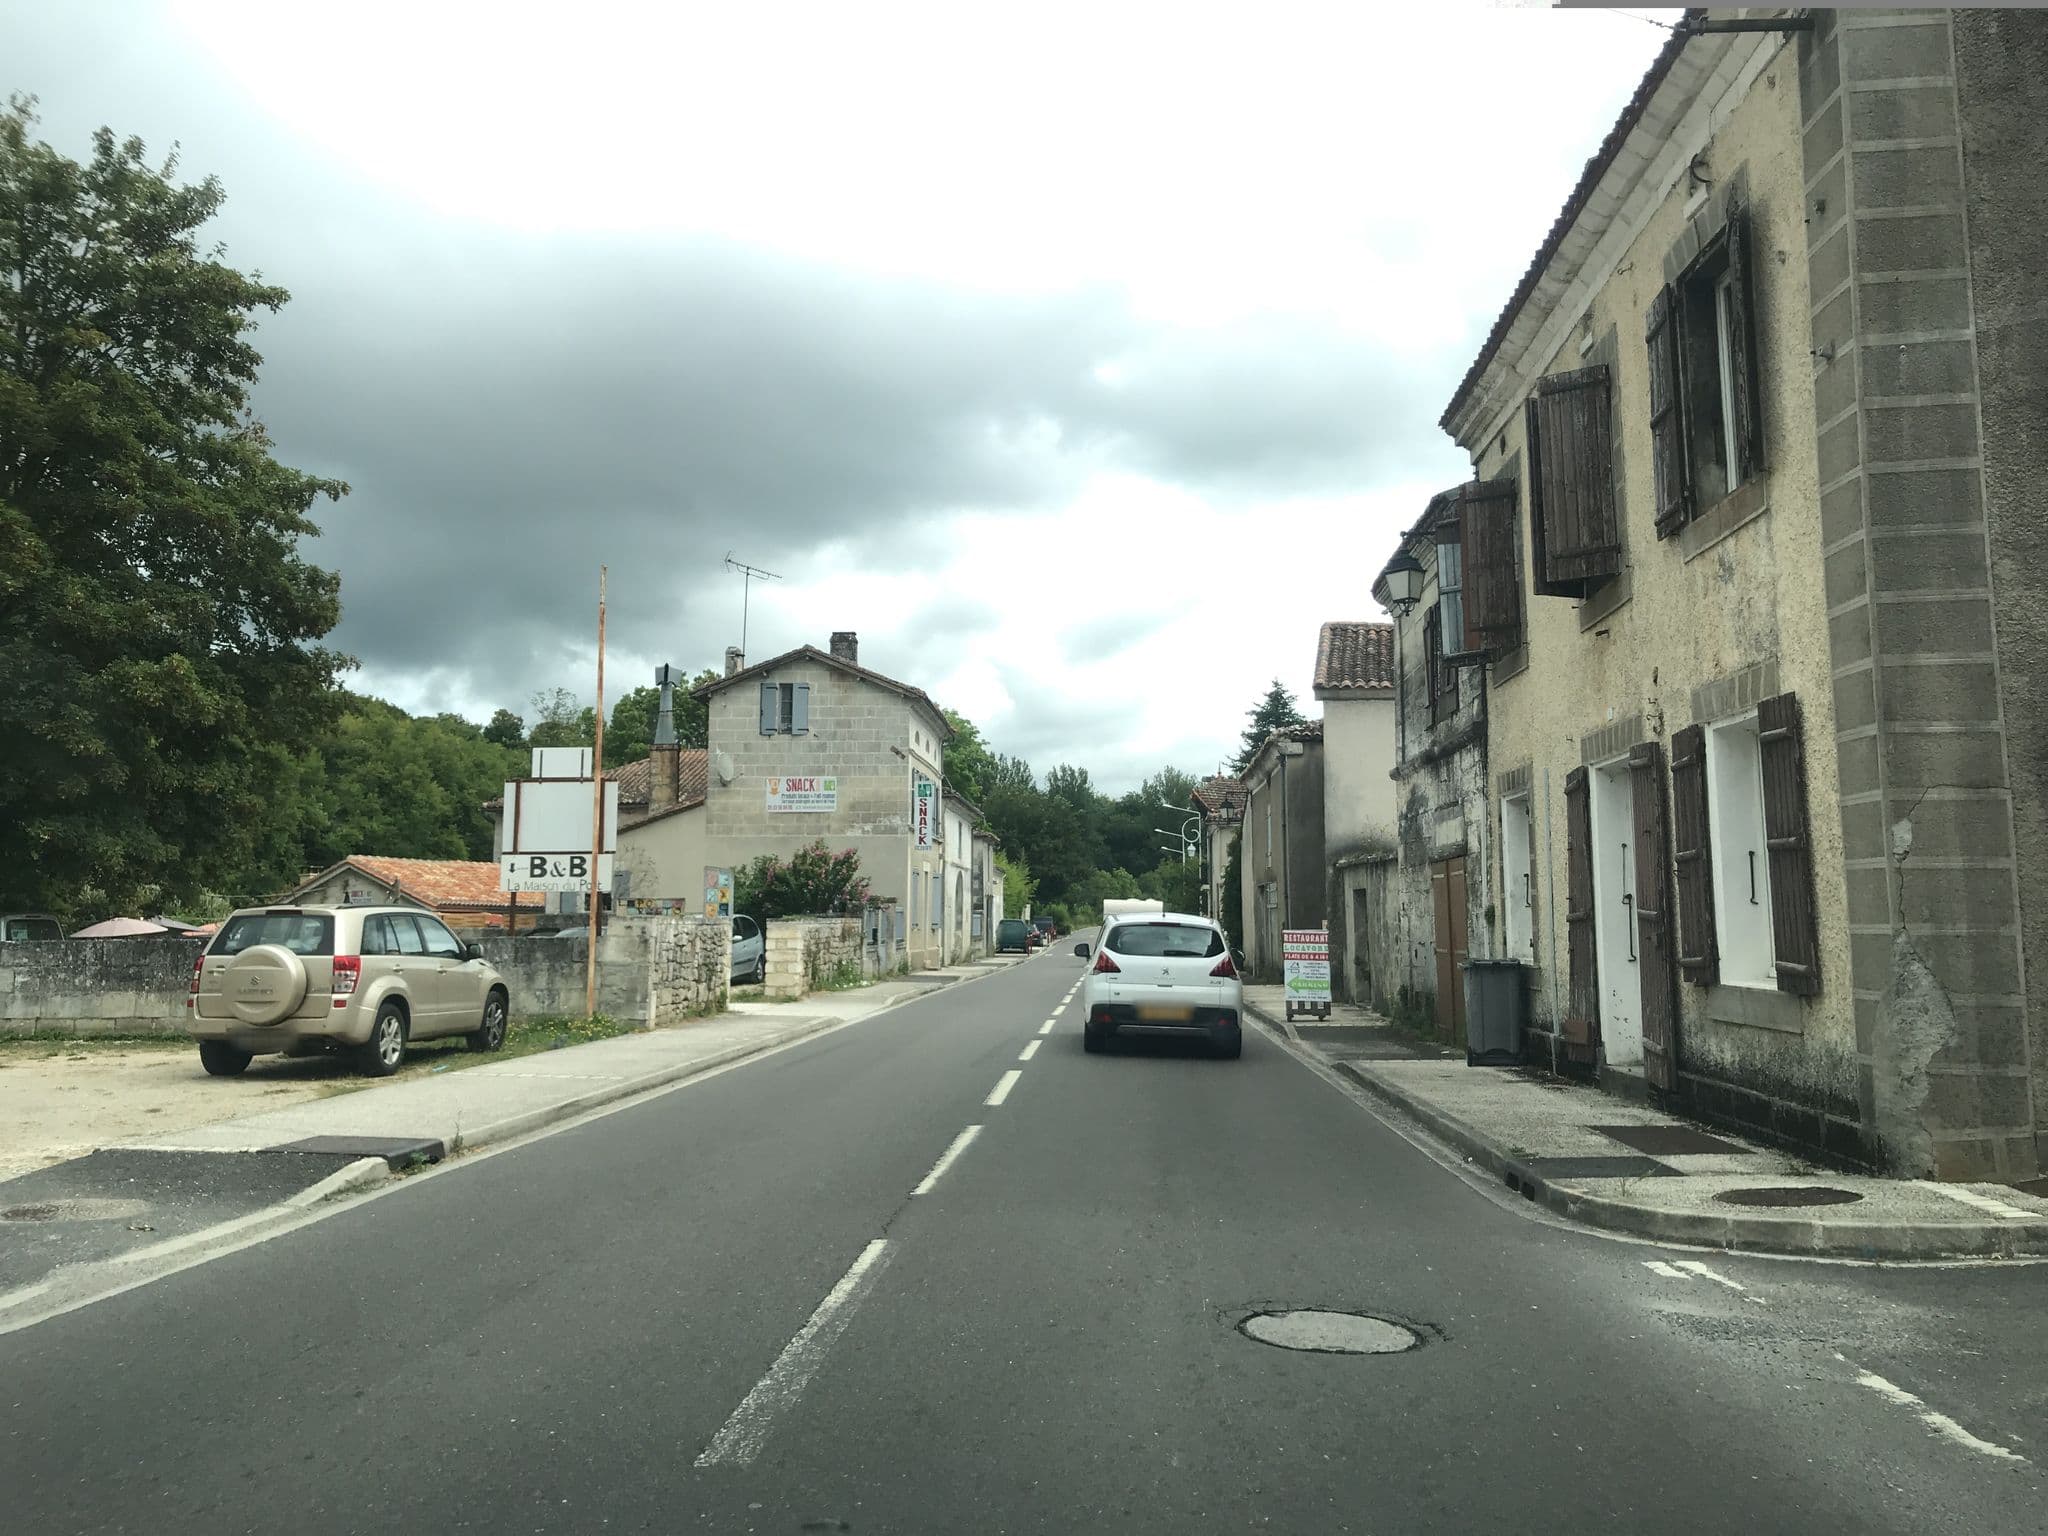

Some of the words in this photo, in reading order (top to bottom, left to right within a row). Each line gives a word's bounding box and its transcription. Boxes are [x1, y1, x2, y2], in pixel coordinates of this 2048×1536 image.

[786, 778, 815, 792] SNACK
[918, 798, 928, 845] SNACK
[507, 878, 520, 891] La
[523, 880, 559, 891] Maison
[562, 879, 576, 891] du
[579, 879, 604, 891] Pot
[1284, 933, 1328, 942] RESTAURANT
